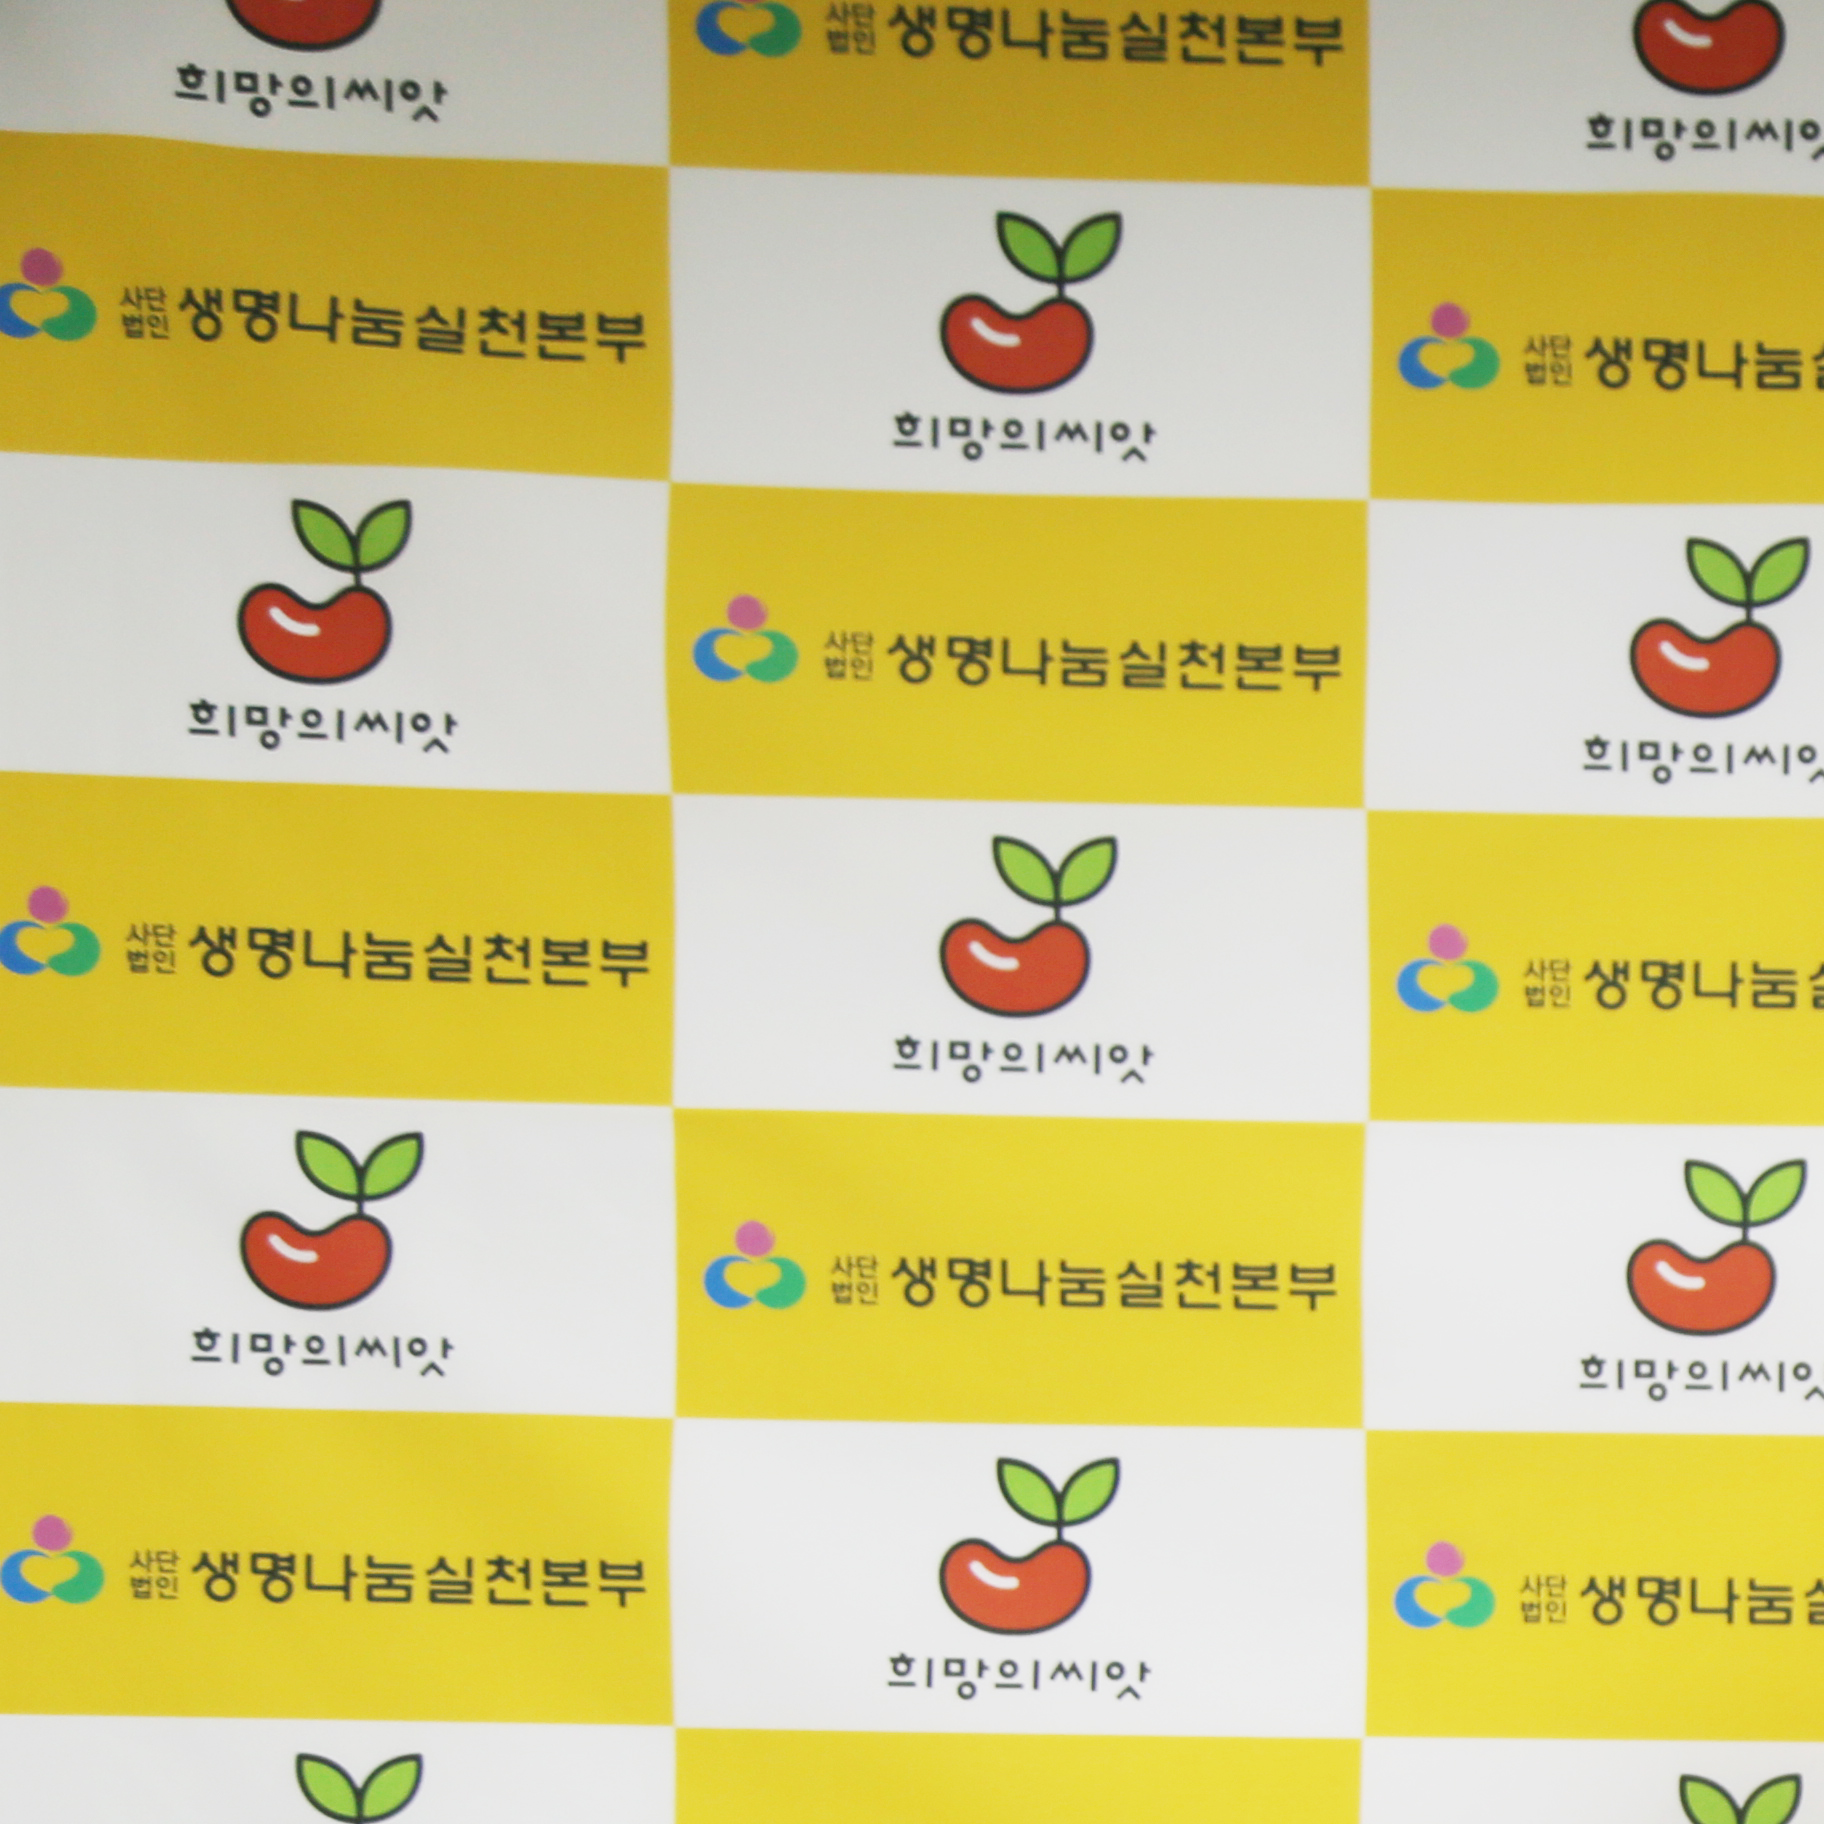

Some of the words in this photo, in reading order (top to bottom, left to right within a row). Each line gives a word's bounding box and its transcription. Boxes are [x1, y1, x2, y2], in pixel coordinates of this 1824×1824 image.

[887, 3, 1344, 68] 생명나눔실천본부
[174, 62, 448, 123] 희망의씨앗
[177, 287, 646, 364] 생명나눔실천본부
[893, 411, 1156, 462] 희망의씨앗
[887, 634, 1341, 692] 생명나눔실천본부
[188, 698, 458, 754] 희망의씨앗
[188, 925, 649, 988] 생명나눔실천본부
[893, 1035, 1153, 1084] 희망의씨앗
[891, 1257, 1337, 1311] 생명나눔실천본부
[191, 1327, 453, 1377] 희망의씨앗
[191, 1551, 646, 1608] 생명나눔실천본부
[888, 1652, 1150, 1701] 희망의씨앗
